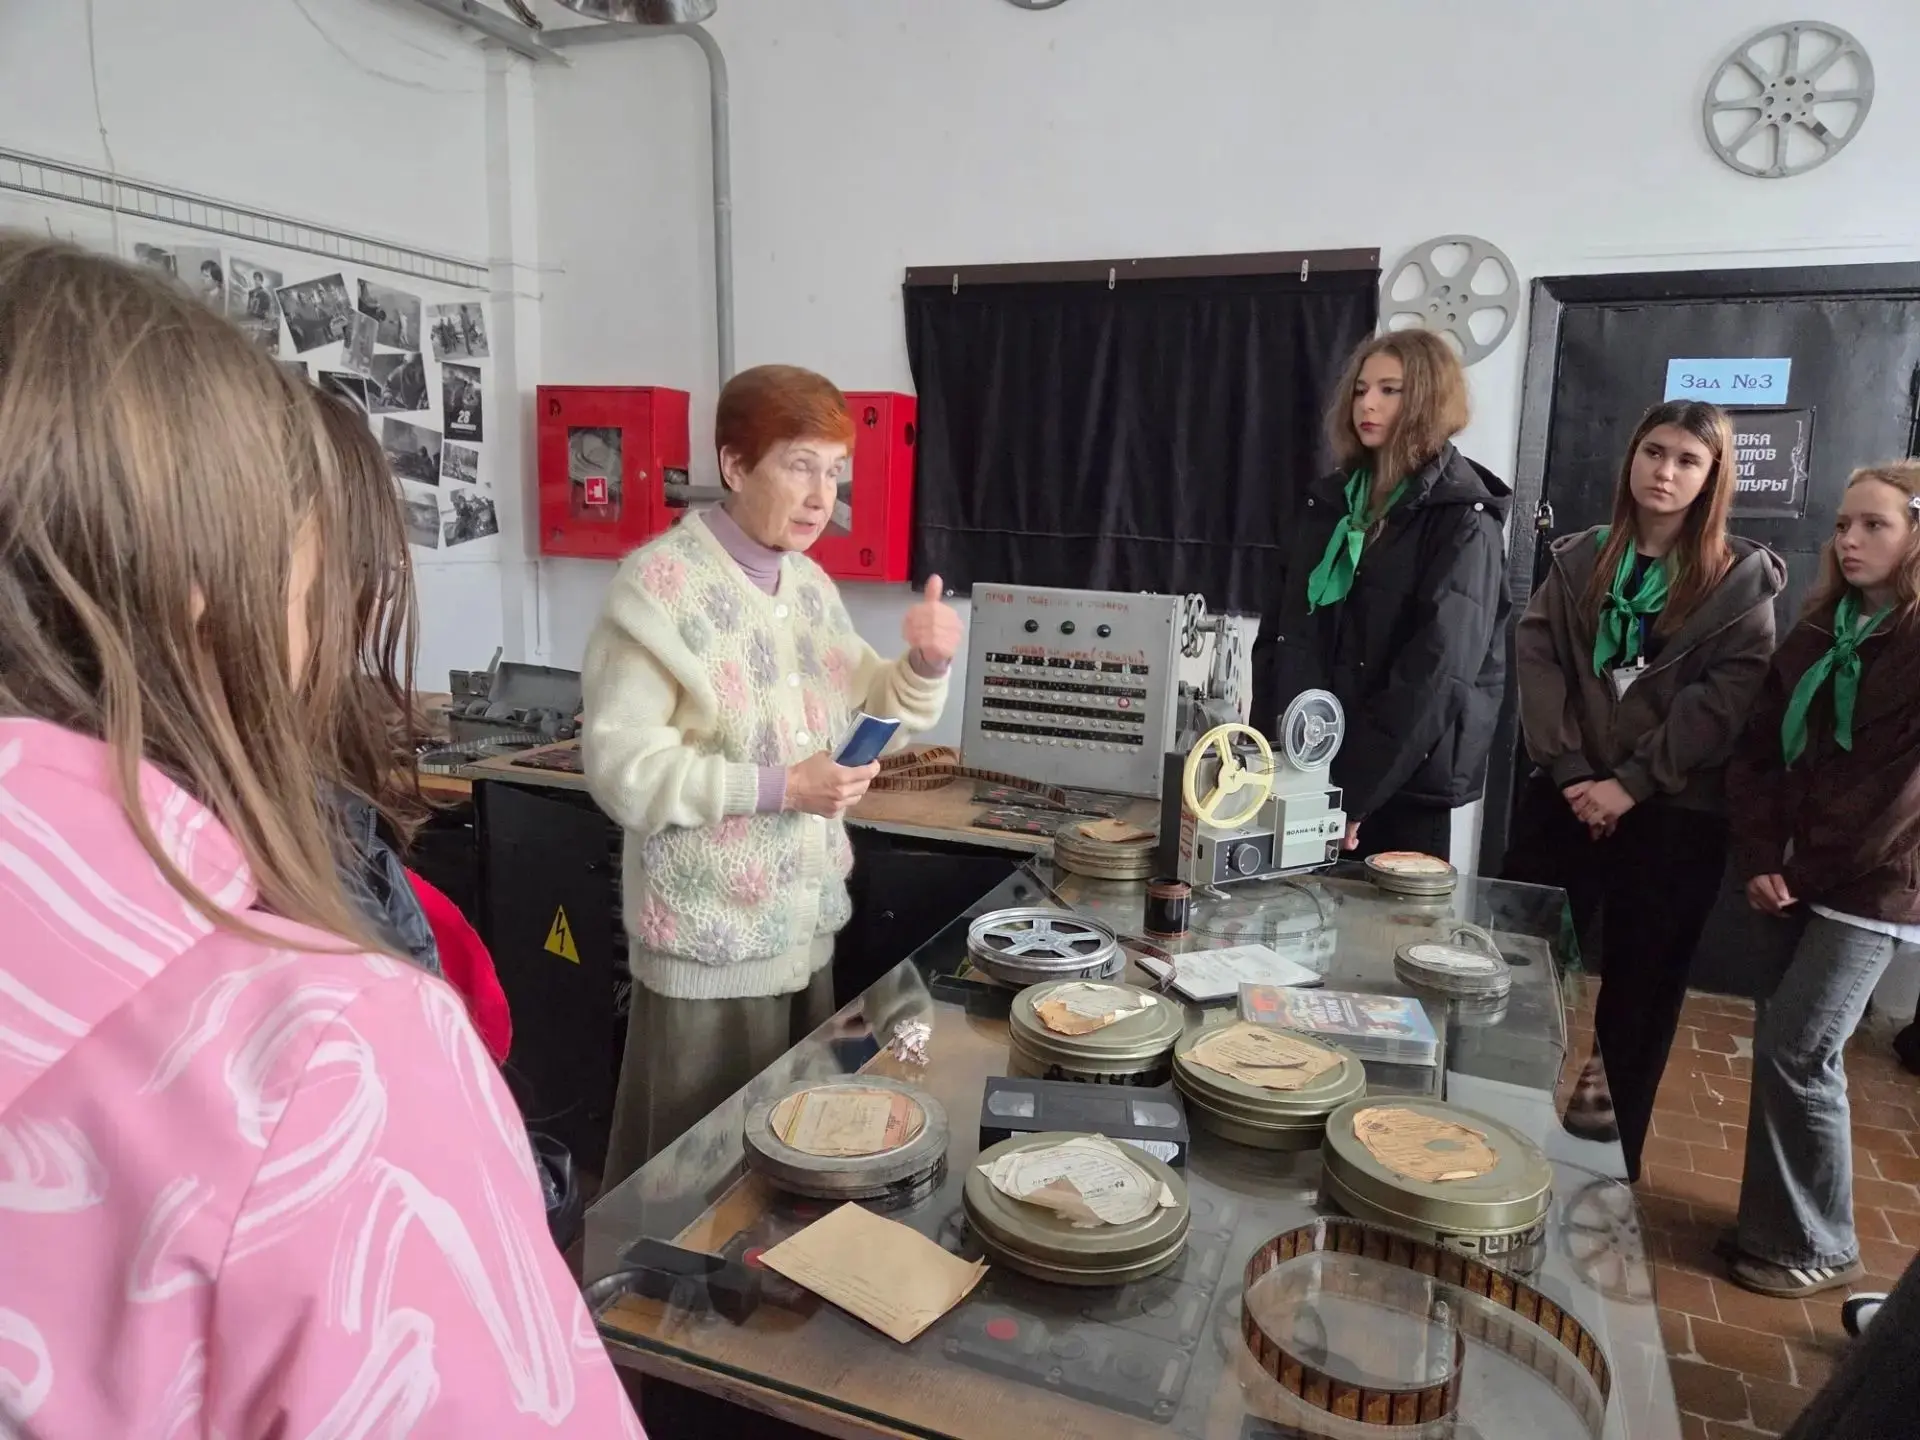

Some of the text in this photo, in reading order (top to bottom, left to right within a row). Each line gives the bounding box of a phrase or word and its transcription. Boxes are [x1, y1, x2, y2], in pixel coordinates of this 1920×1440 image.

[1680, 374, 1774, 389] Зал №3
[457, 409, 471, 424] 28
[1736, 462, 1755, 477] ОЙ
[1736, 479, 1789, 492] ТУРЫ
